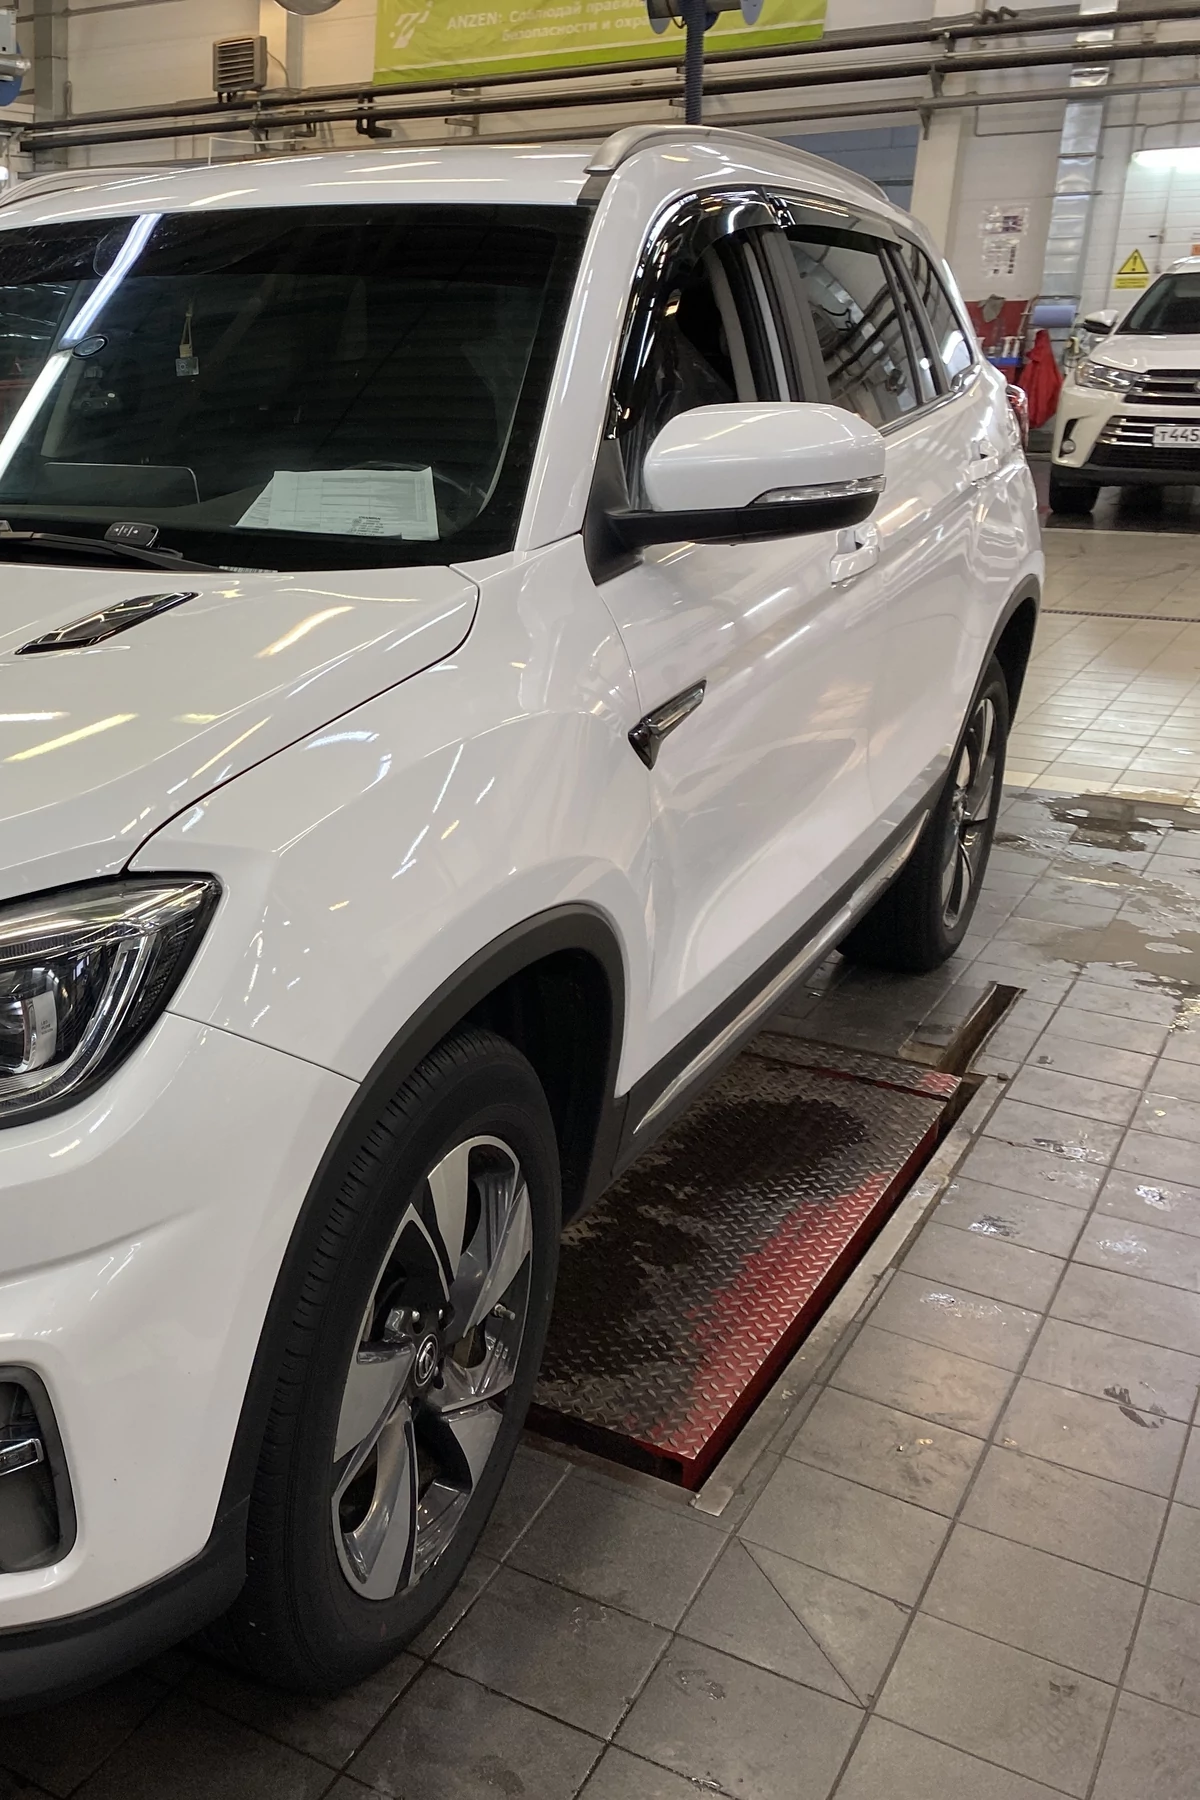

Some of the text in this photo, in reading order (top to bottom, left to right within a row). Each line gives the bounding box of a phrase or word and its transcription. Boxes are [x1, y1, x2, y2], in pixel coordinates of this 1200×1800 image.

[446, 11, 502, 31] ANZEN:
[509, 0, 581, 23] Соблюдай
[615, 16, 649, 29] охра
